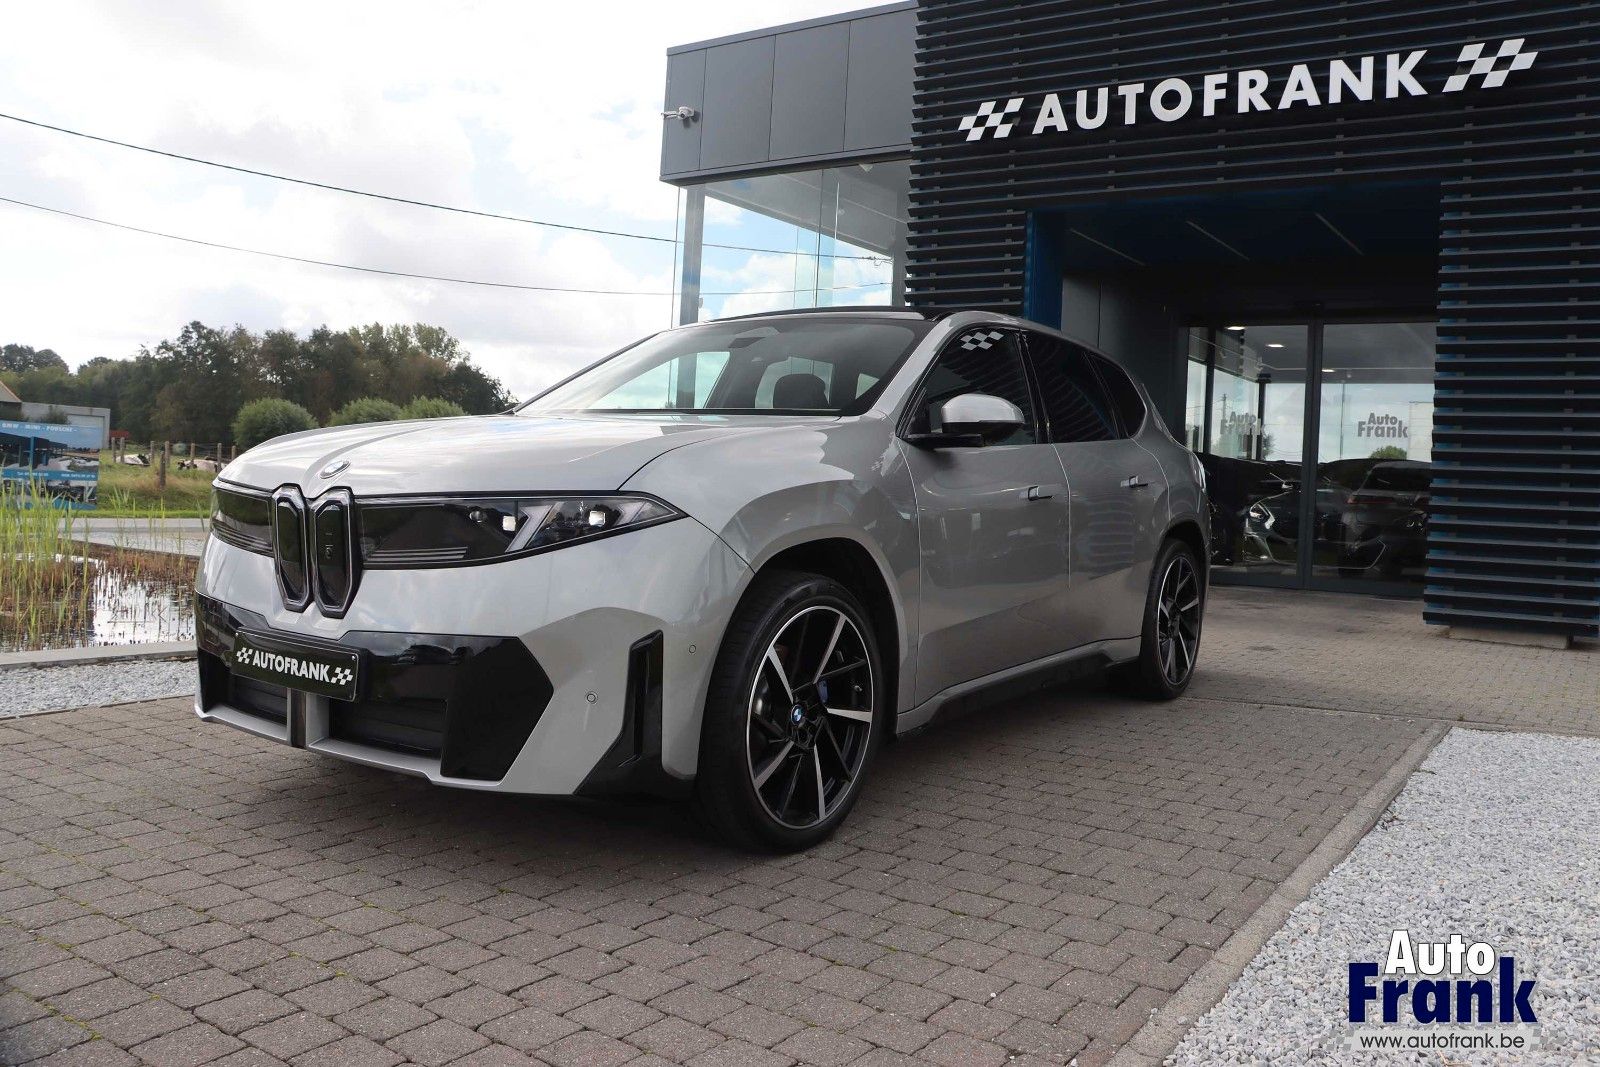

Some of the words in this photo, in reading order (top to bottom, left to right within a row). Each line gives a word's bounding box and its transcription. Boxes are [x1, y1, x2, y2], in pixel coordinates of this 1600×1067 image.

[1032, 50, 1427, 135] AUTOFRANK
[1229, 411, 1257, 424] Auto
[1367, 412, 1398, 425] Auto
[1357, 420, 1408, 438] Frank
[252, 650, 330, 682] AUTOFRANK
